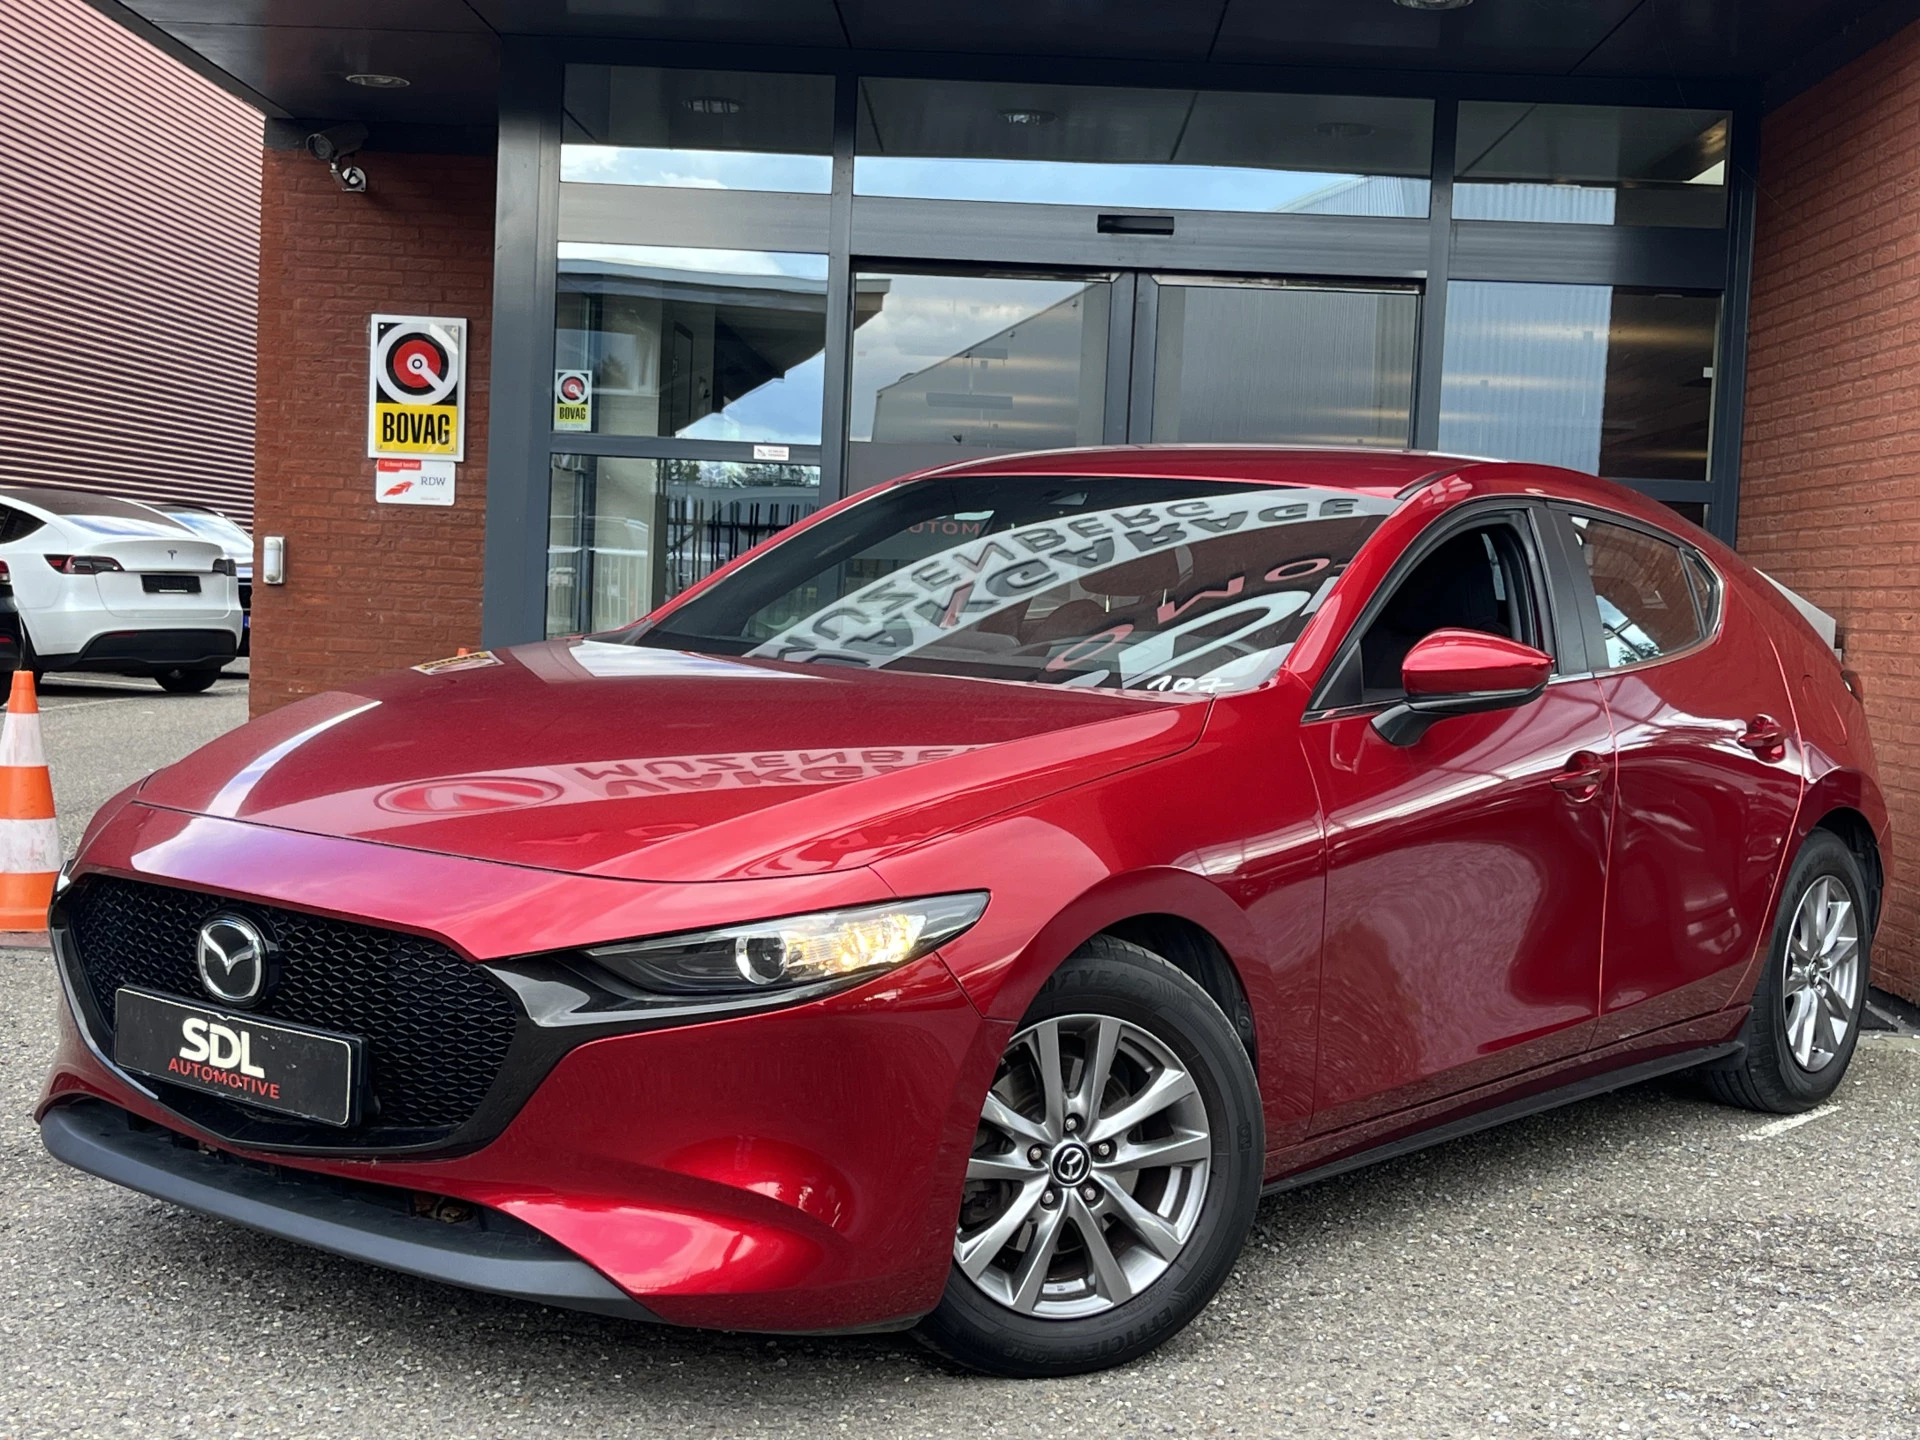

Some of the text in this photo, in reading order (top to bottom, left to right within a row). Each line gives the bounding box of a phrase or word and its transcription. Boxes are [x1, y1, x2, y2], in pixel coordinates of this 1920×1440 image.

[559, 407, 586, 420] BOVAG
[382, 412, 450, 445] BOVAG
[420, 476, 446, 486] RDW
[1147, 675, 1234, 693] 107
[179, 1017, 265, 1079] SDL
[168, 1057, 280, 1099] AUTOMOTIVE
